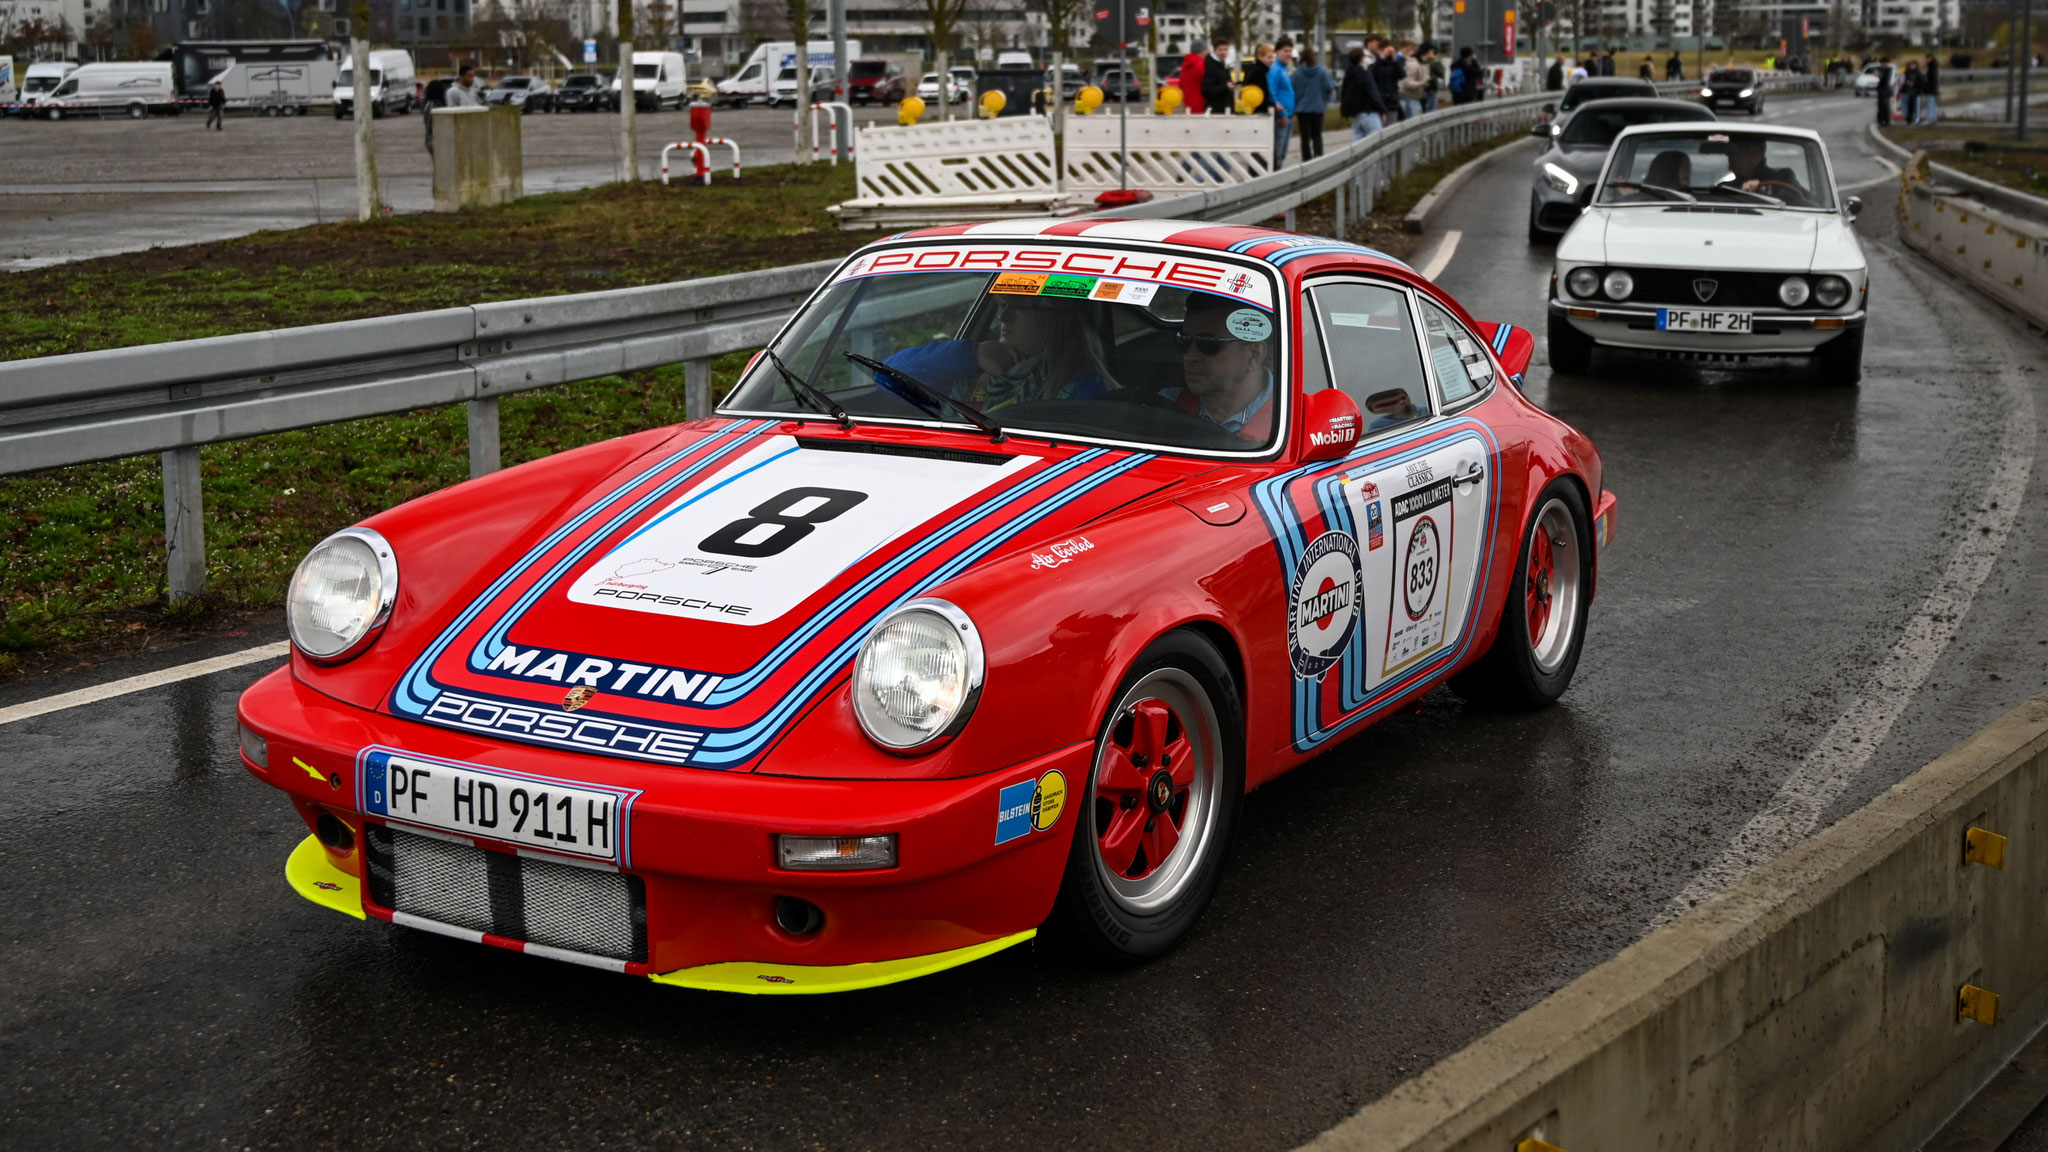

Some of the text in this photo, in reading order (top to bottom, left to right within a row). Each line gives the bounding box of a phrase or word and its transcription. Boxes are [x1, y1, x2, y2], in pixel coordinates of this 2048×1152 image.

[867, 250, 1225, 288] PORSCHE
[1668, 311, 1751, 330] PF HF 2H
[1309, 428, 1354, 446] Mobil 1
[1405, 460, 1428, 474] SAVE THE
[1407, 470, 1434, 488] CLASSICS
[1394, 499, 1409, 518] ADAC
[1423, 483, 1451, 506] KILOMETER
[697, 486, 869, 559] 8
[683, 557, 759, 570] PORSCHE
[1031, 536, 1095, 569] Air Cooled
[1410, 556, 1433, 594] 833
[593, 588, 753, 616] PORSCHE
[1289, 533, 1362, 652] MARTINI INTERNATIONAL CLUB
[1302, 582, 1350, 627] MARTINI
[486, 645, 724, 702] MARTINI
[426, 696, 700, 757] PORSCHE
[374, 790, 381, 804] D
[390, 763, 609, 849] PF HD 911 H
[999, 802, 1031, 823] BILSTEIN
